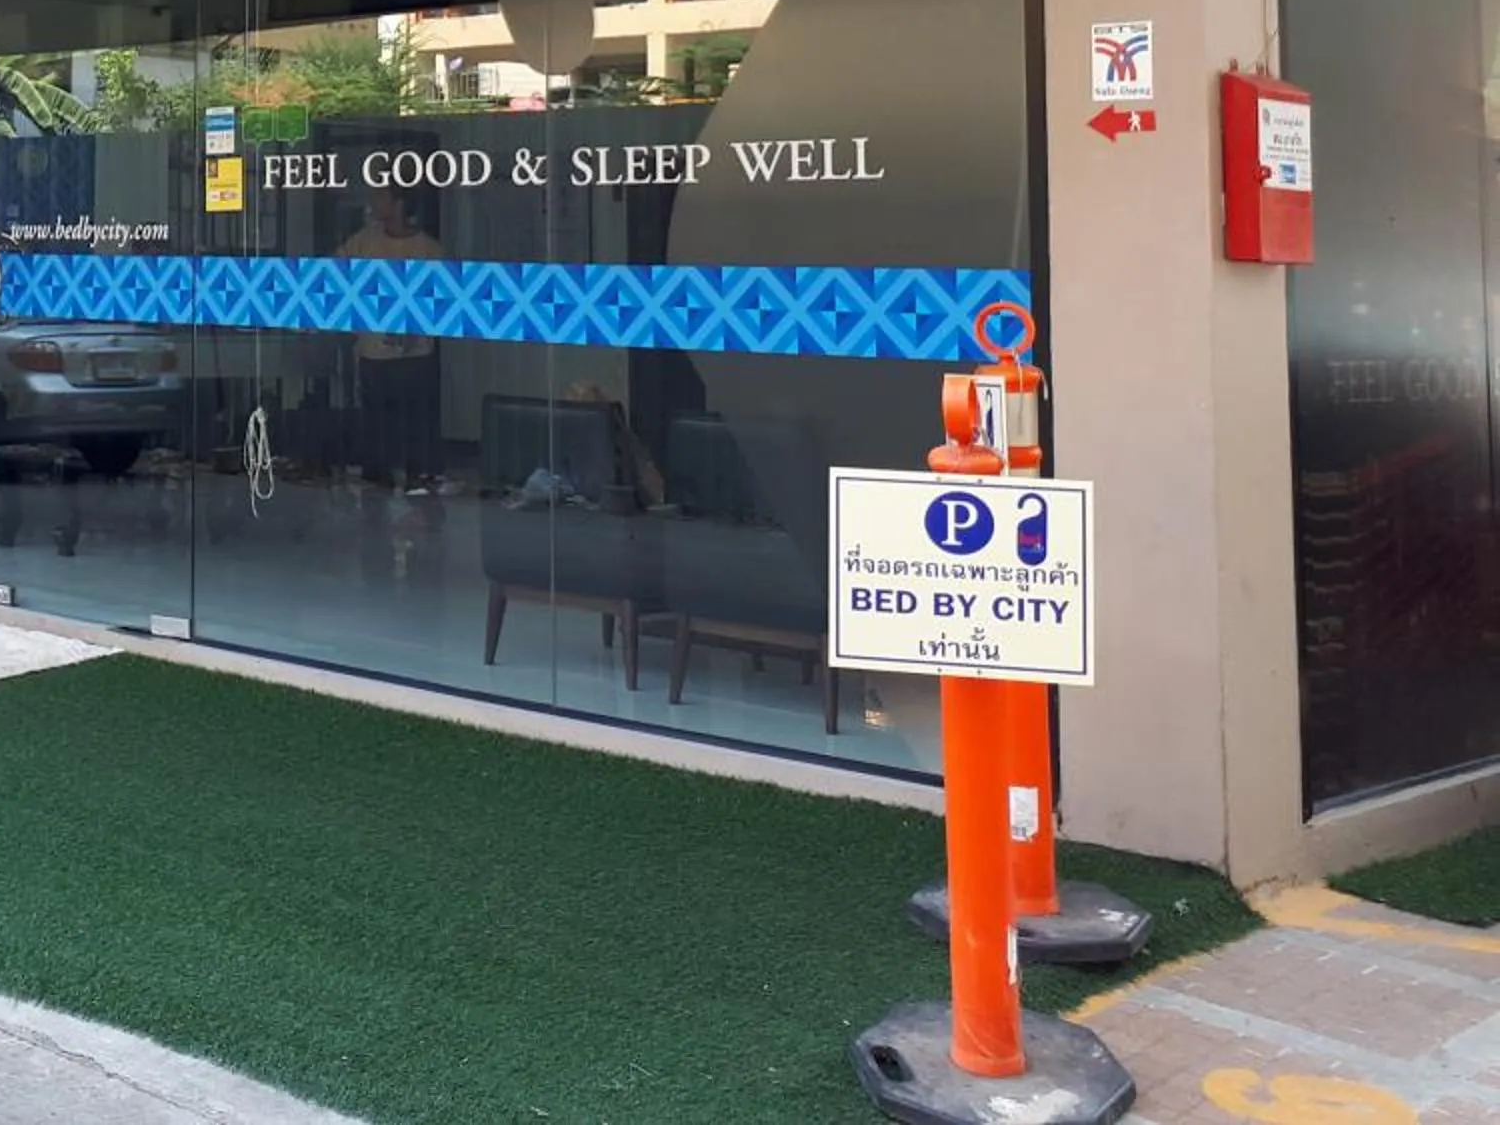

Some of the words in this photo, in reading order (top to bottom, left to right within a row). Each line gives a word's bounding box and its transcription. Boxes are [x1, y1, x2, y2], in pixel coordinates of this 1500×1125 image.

[263, 154, 349, 190] FEEL
[362, 150, 493, 189] GOOD
[511, 147, 549, 186] &
[571, 144, 711, 187] SLEEP
[729, 136, 886, 183] WELL
[9, 216, 169, 244] www.bedbycity.com
[940, 499, 979, 546] P
[844, 545, 1079, 591] ที่จอดรถเฉพาะลูกค้า
[850, 587, 918, 615] BED
[932, 592, 978, 619] BY
[991, 596, 1070, 624] CITY
[918, 627, 1001, 661] เท่านั้น
